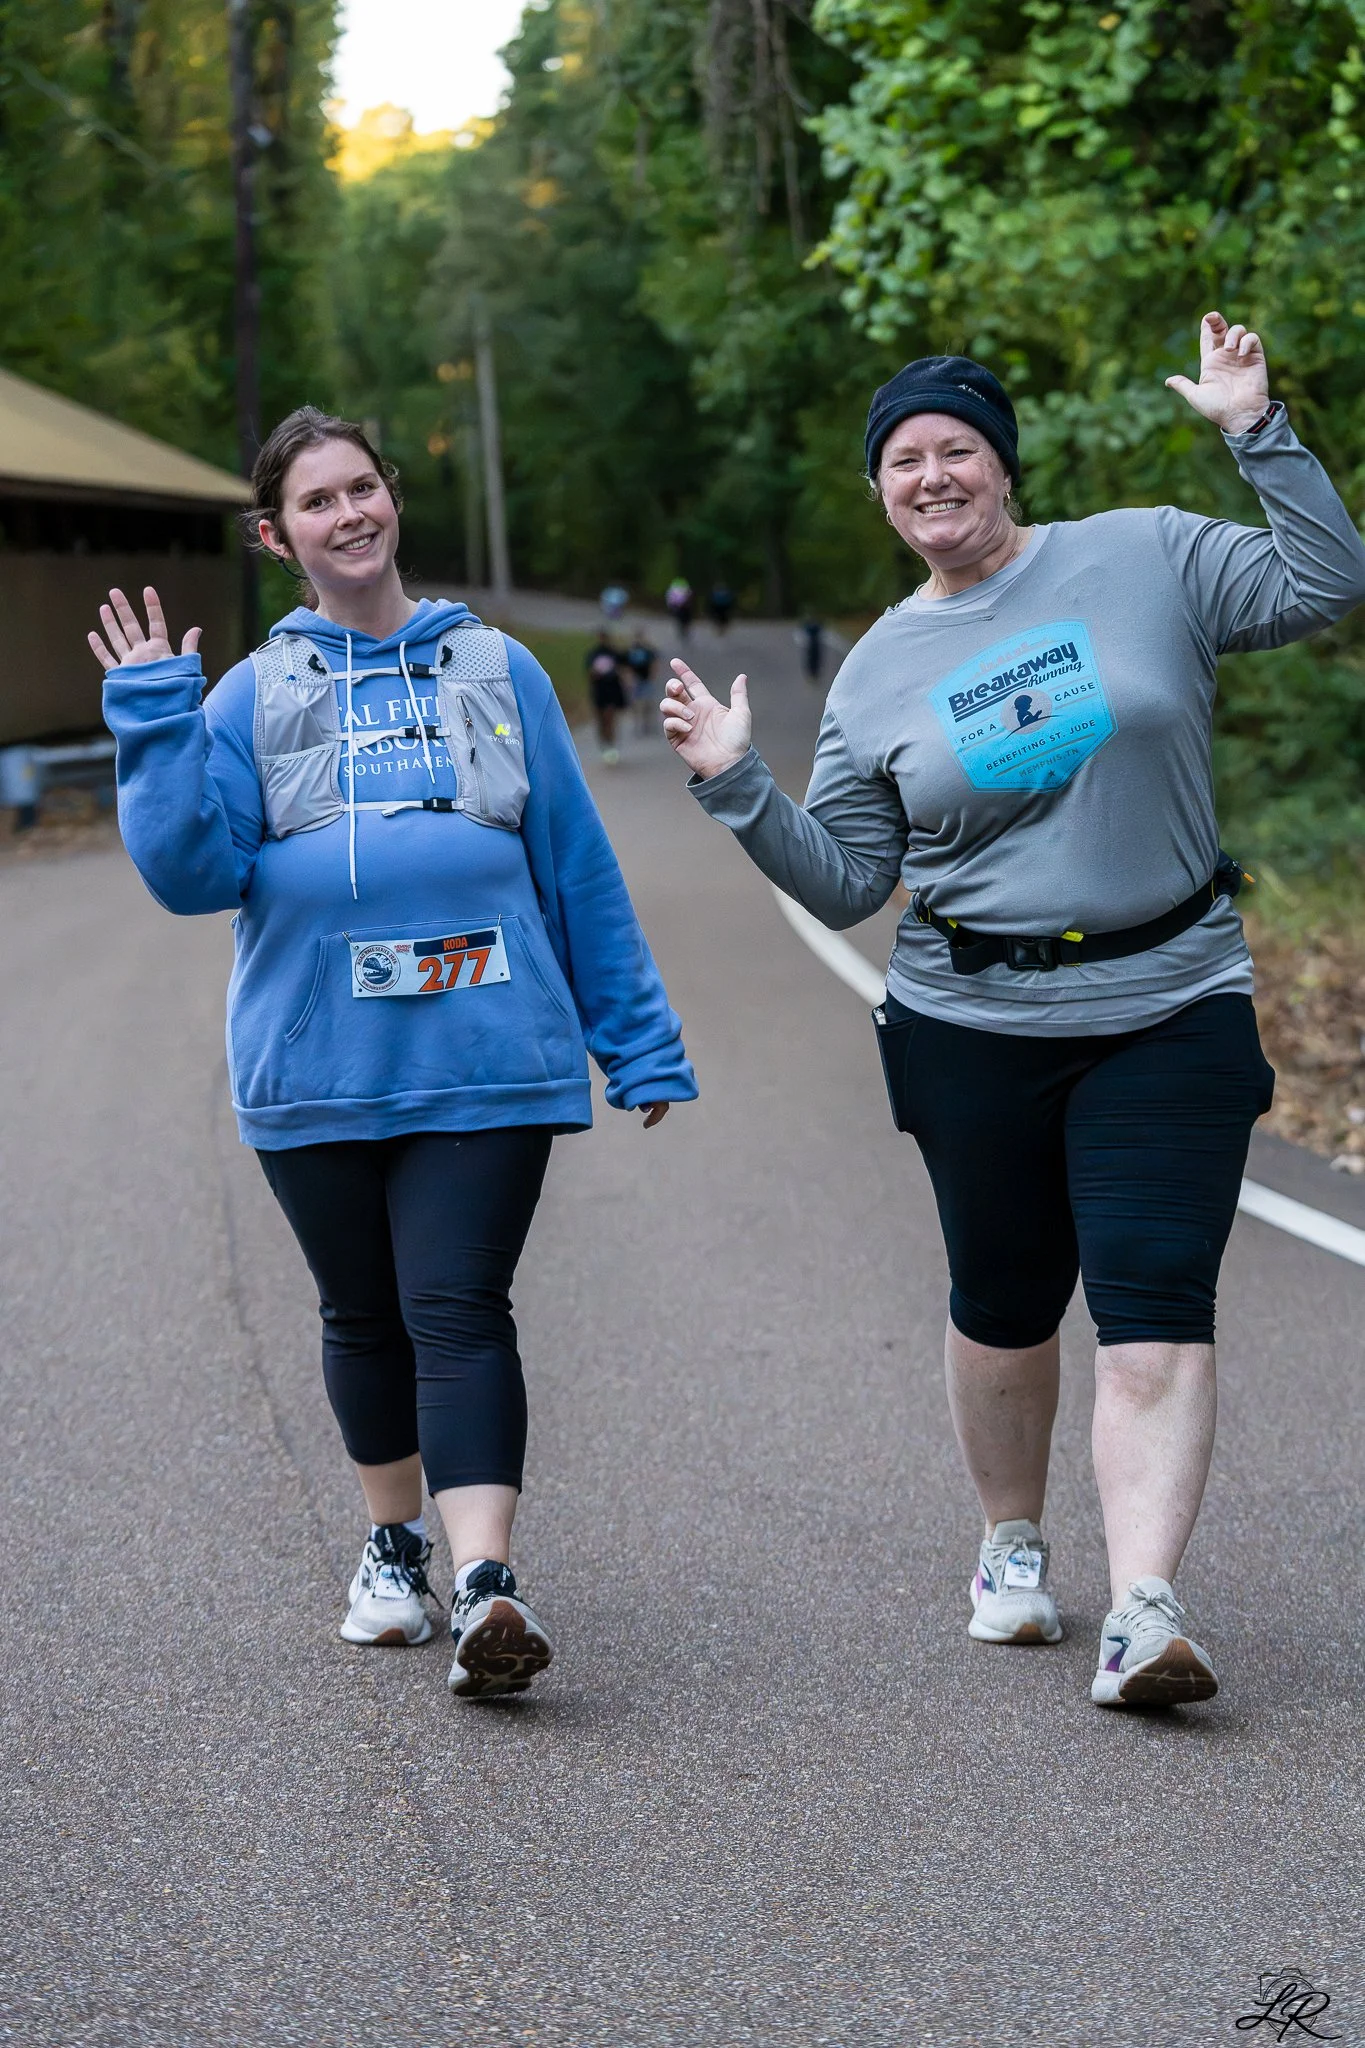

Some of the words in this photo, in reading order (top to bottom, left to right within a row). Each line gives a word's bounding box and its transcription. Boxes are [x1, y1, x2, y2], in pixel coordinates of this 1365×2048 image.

[948, 641, 1079, 713] Breakaway
[1028, 660, 1086, 688] Running
[338, 703, 380, 728] AL
[960, 728, 984, 744] FOR
[989, 723, 997, 732] A
[1054, 681, 1096, 702] CAUSE
[986, 739, 1047, 771] BENEFITING
[1050, 732, 1066, 743] ST.
[1069, 719, 1096, 735] JUDE
[443, 937, 468, 951] KODA
[418, 947, 492, 992] 277
